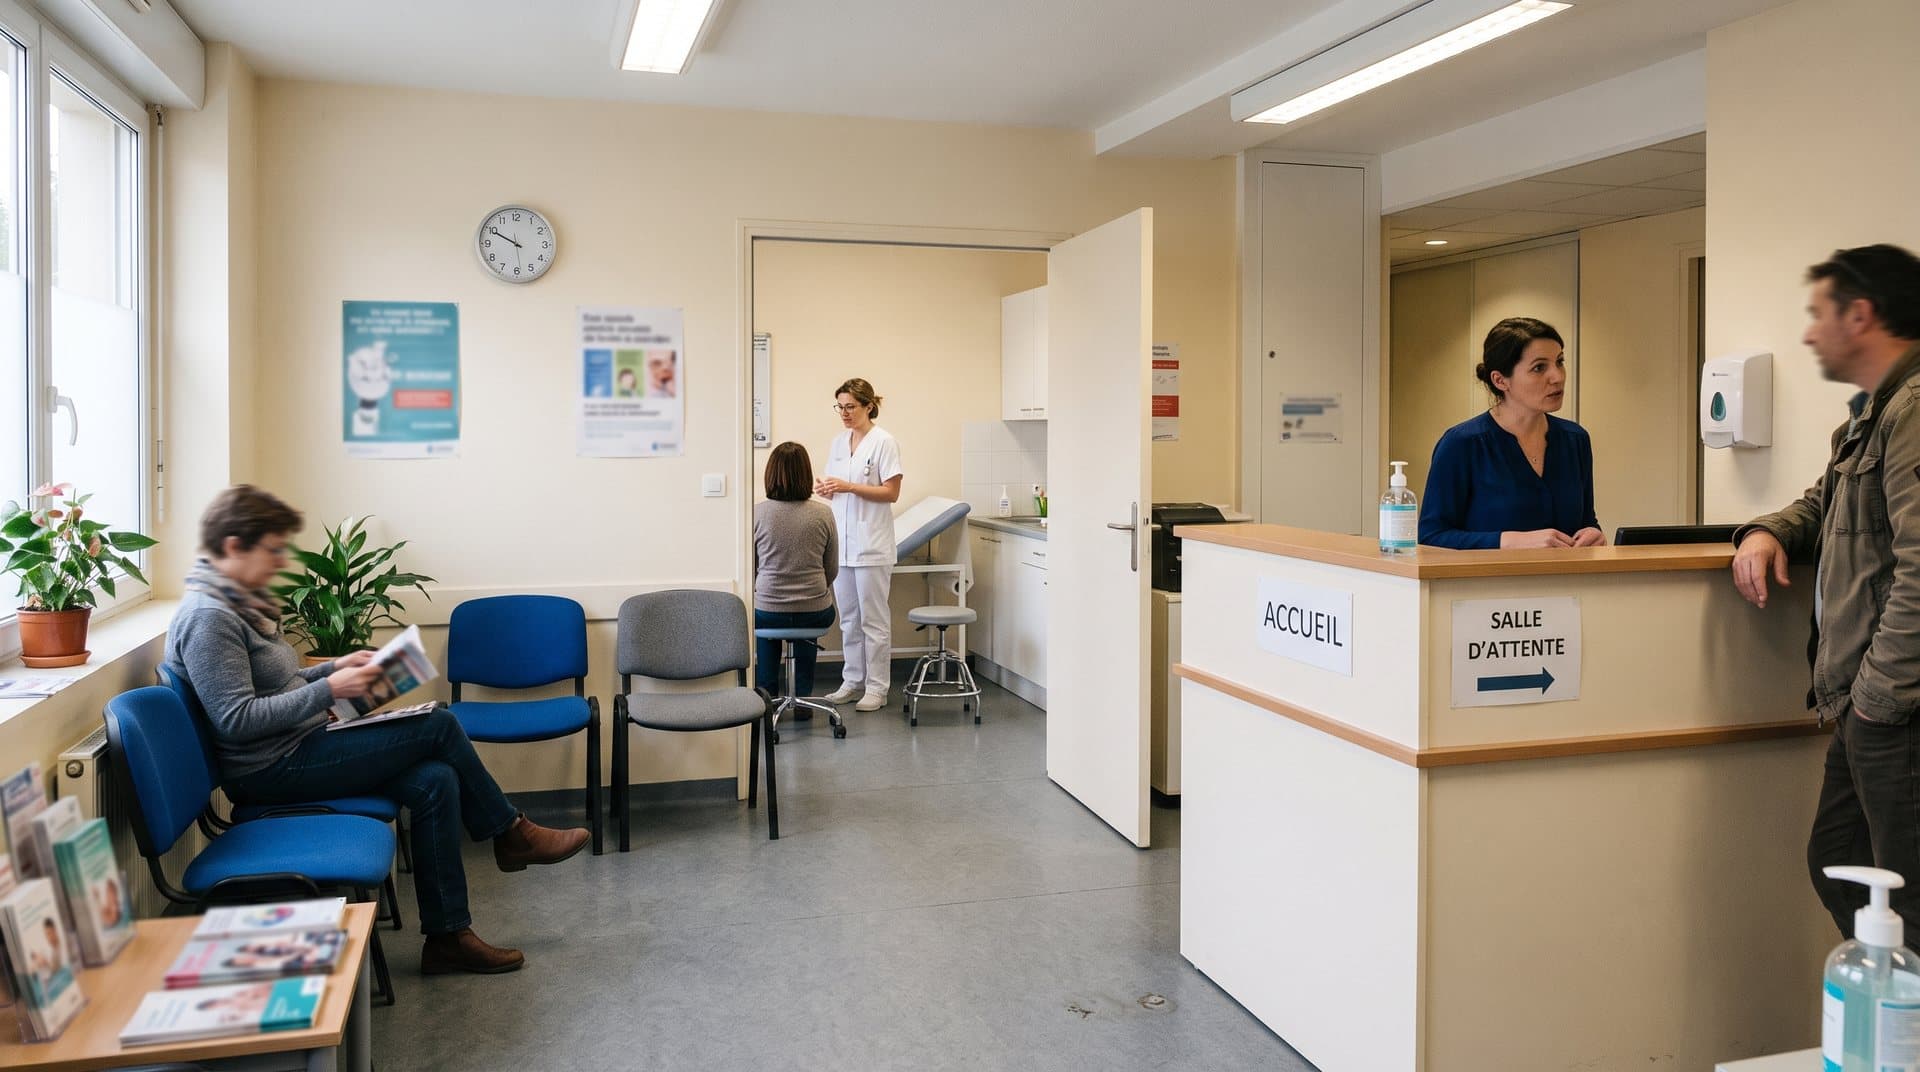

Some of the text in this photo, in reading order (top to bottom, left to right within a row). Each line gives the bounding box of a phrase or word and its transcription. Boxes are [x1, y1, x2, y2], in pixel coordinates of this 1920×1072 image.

[499, 217, 506, 225] 11
[512, 213, 521, 222] 12
[489, 226, 498, 235] 10
[537, 227, 543, 235] 2
[485, 240, 491, 248] 9
[542, 241, 549, 249] 3
[489, 253, 495, 261] 8
[537, 254, 543, 262] 4
[500, 263, 505, 271] 7
[513, 266, 520, 275] 6
[527, 264, 534, 272] 5
[1263, 601, 1343, 647] ACCUEIL
[1490, 610, 1543, 630] SALLE
